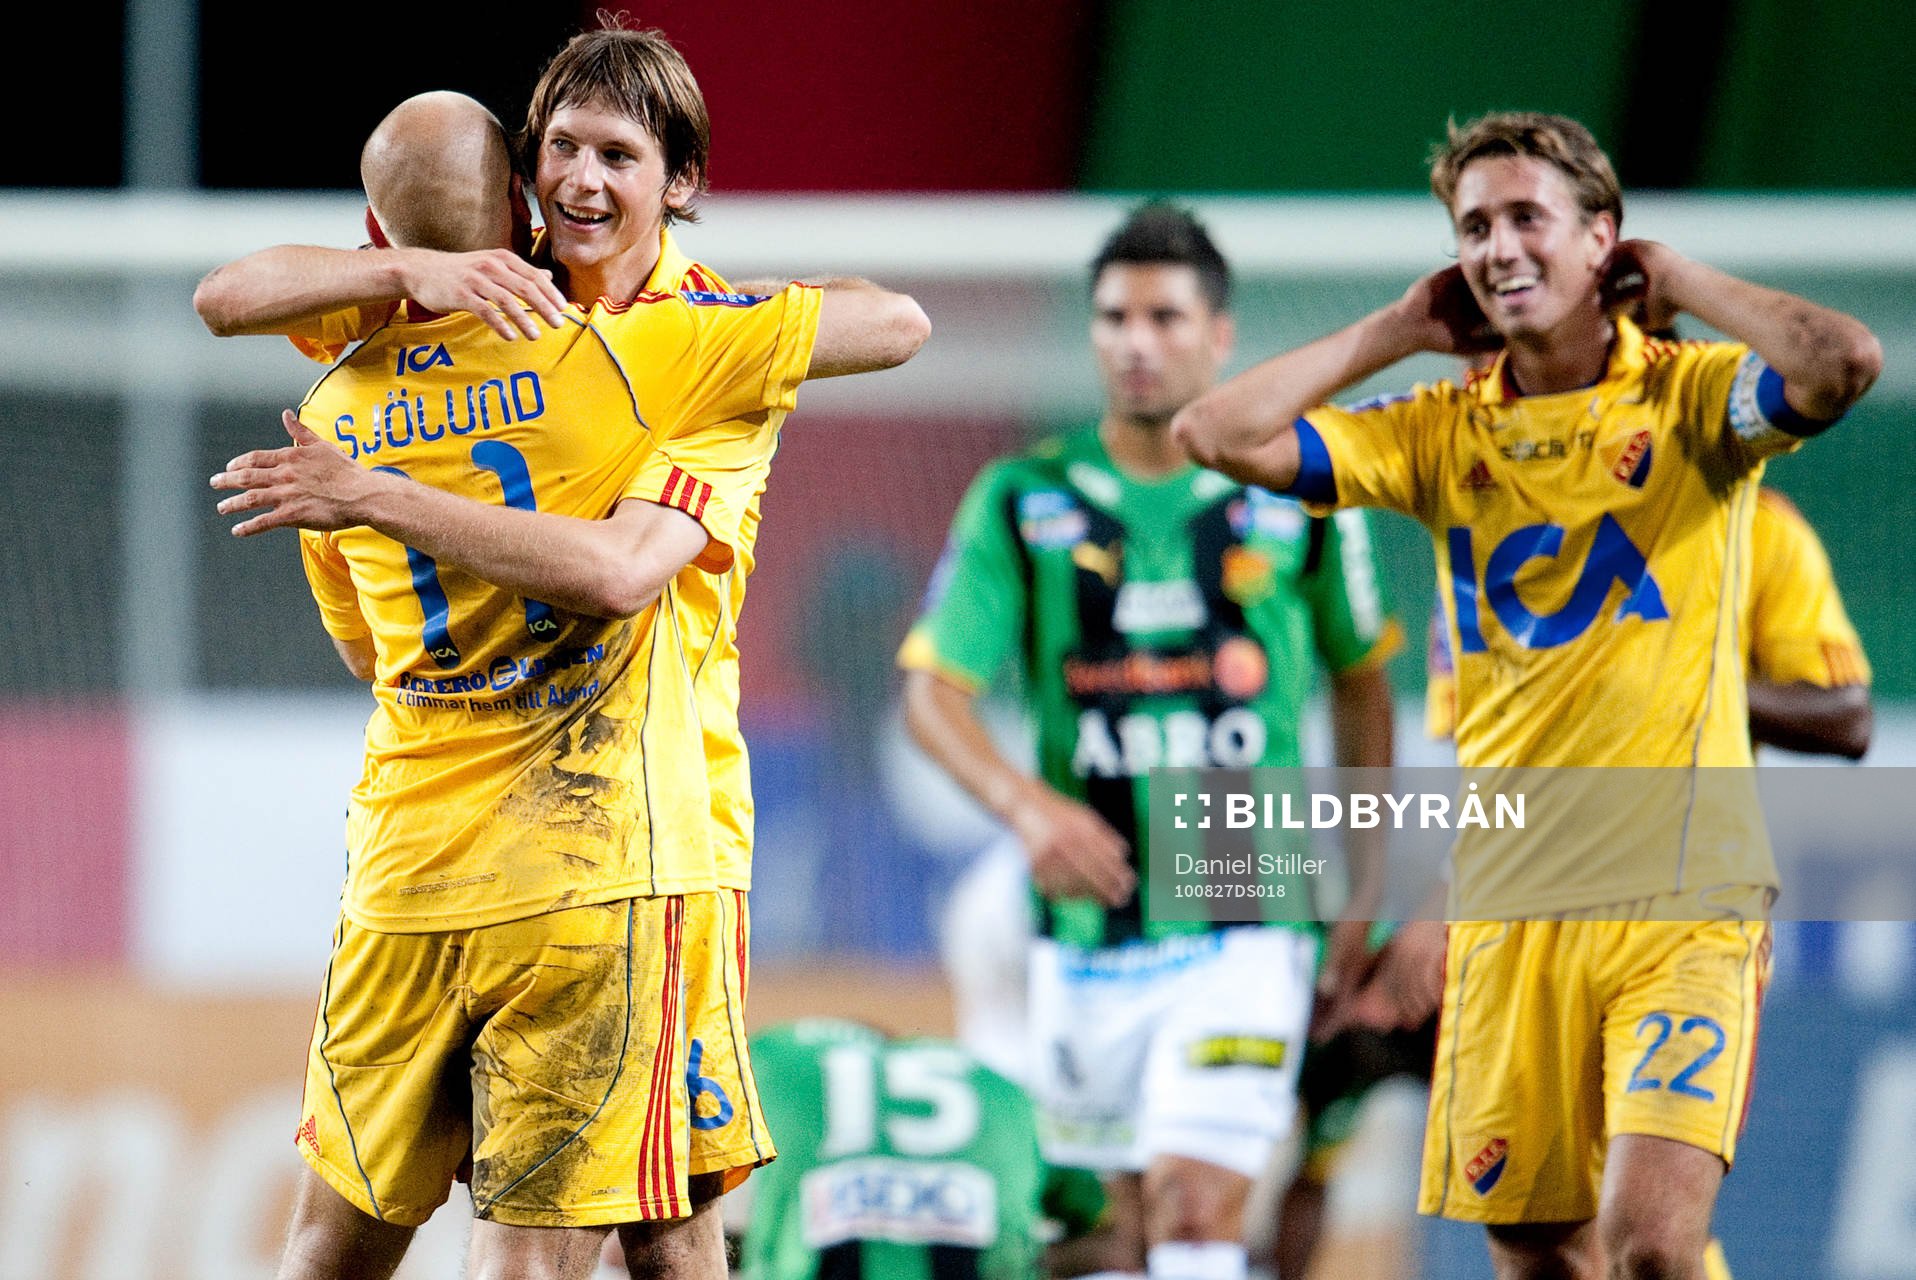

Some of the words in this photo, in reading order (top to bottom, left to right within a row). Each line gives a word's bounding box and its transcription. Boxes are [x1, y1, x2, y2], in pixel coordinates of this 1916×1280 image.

[397, 342, 455, 376] ICA
[335, 371, 545, 460] SJÖLUND
[528, 619, 558, 634] ICA
[1447, 512, 1669, 653] ICA
[430, 647, 458, 660] ICA
[406, 691, 466, 710] timmar
[468, 697, 512, 713] hem
[686, 1039, 734, 1130] 6
[1626, 1011, 1727, 1103] 22
[815, 1046, 979, 1158] 15
